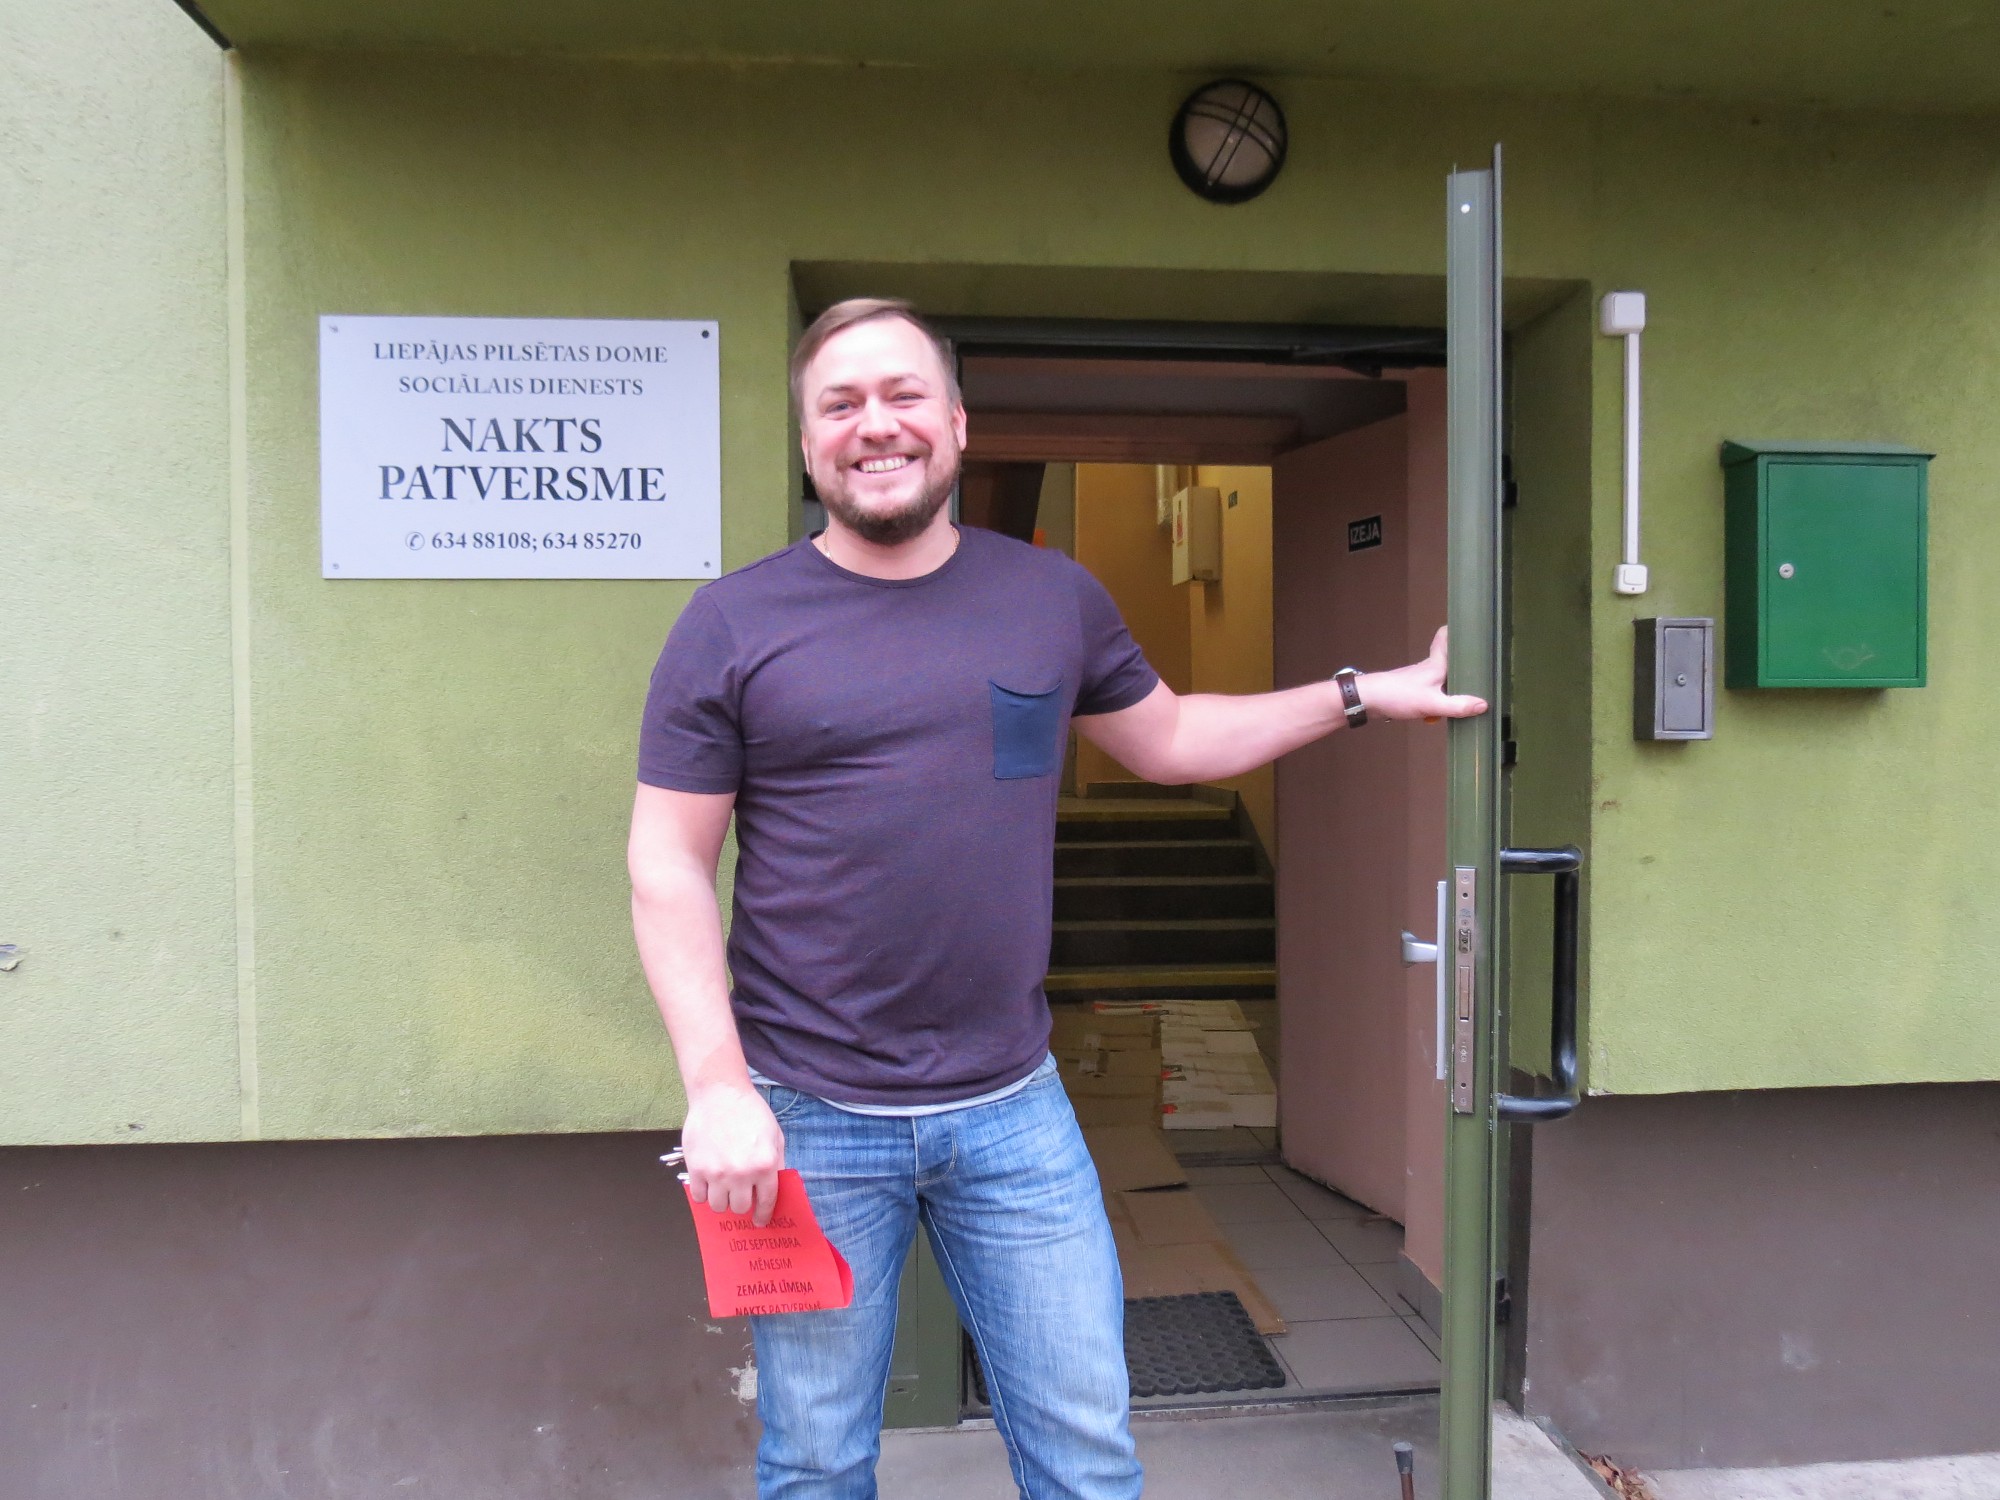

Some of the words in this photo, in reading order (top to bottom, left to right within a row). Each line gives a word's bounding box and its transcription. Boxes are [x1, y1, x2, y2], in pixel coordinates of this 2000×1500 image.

[374, 341, 478, 365] LIEPĀJAS
[484, 341, 590, 363] PILSĒTAS
[595, 345, 668, 364] DOME
[399, 373, 523, 395] SOCIĀLAIS
[530, 378, 644, 396] DIENESTS
[440, 416, 603, 454] NAKTS
[377, 464, 667, 502] PATVERSME
[431, 532, 467, 550] 634
[472, 532, 538, 553] 88108;
[543, 532, 577, 550] 634
[583, 532, 642, 550] 85270
[1350, 522, 1380, 545] IZEJA
[719, 1220, 733, 1232] NO
[729, 1239, 748, 1252] LĪDZ
[749, 1237, 801, 1250] SEPTEMBRA
[749, 1258, 792, 1271] MĒNESIM
[737, 1280, 778, 1296] ZEMĀKĀ
[778, 1279, 813, 1295] LĪMEŅA
